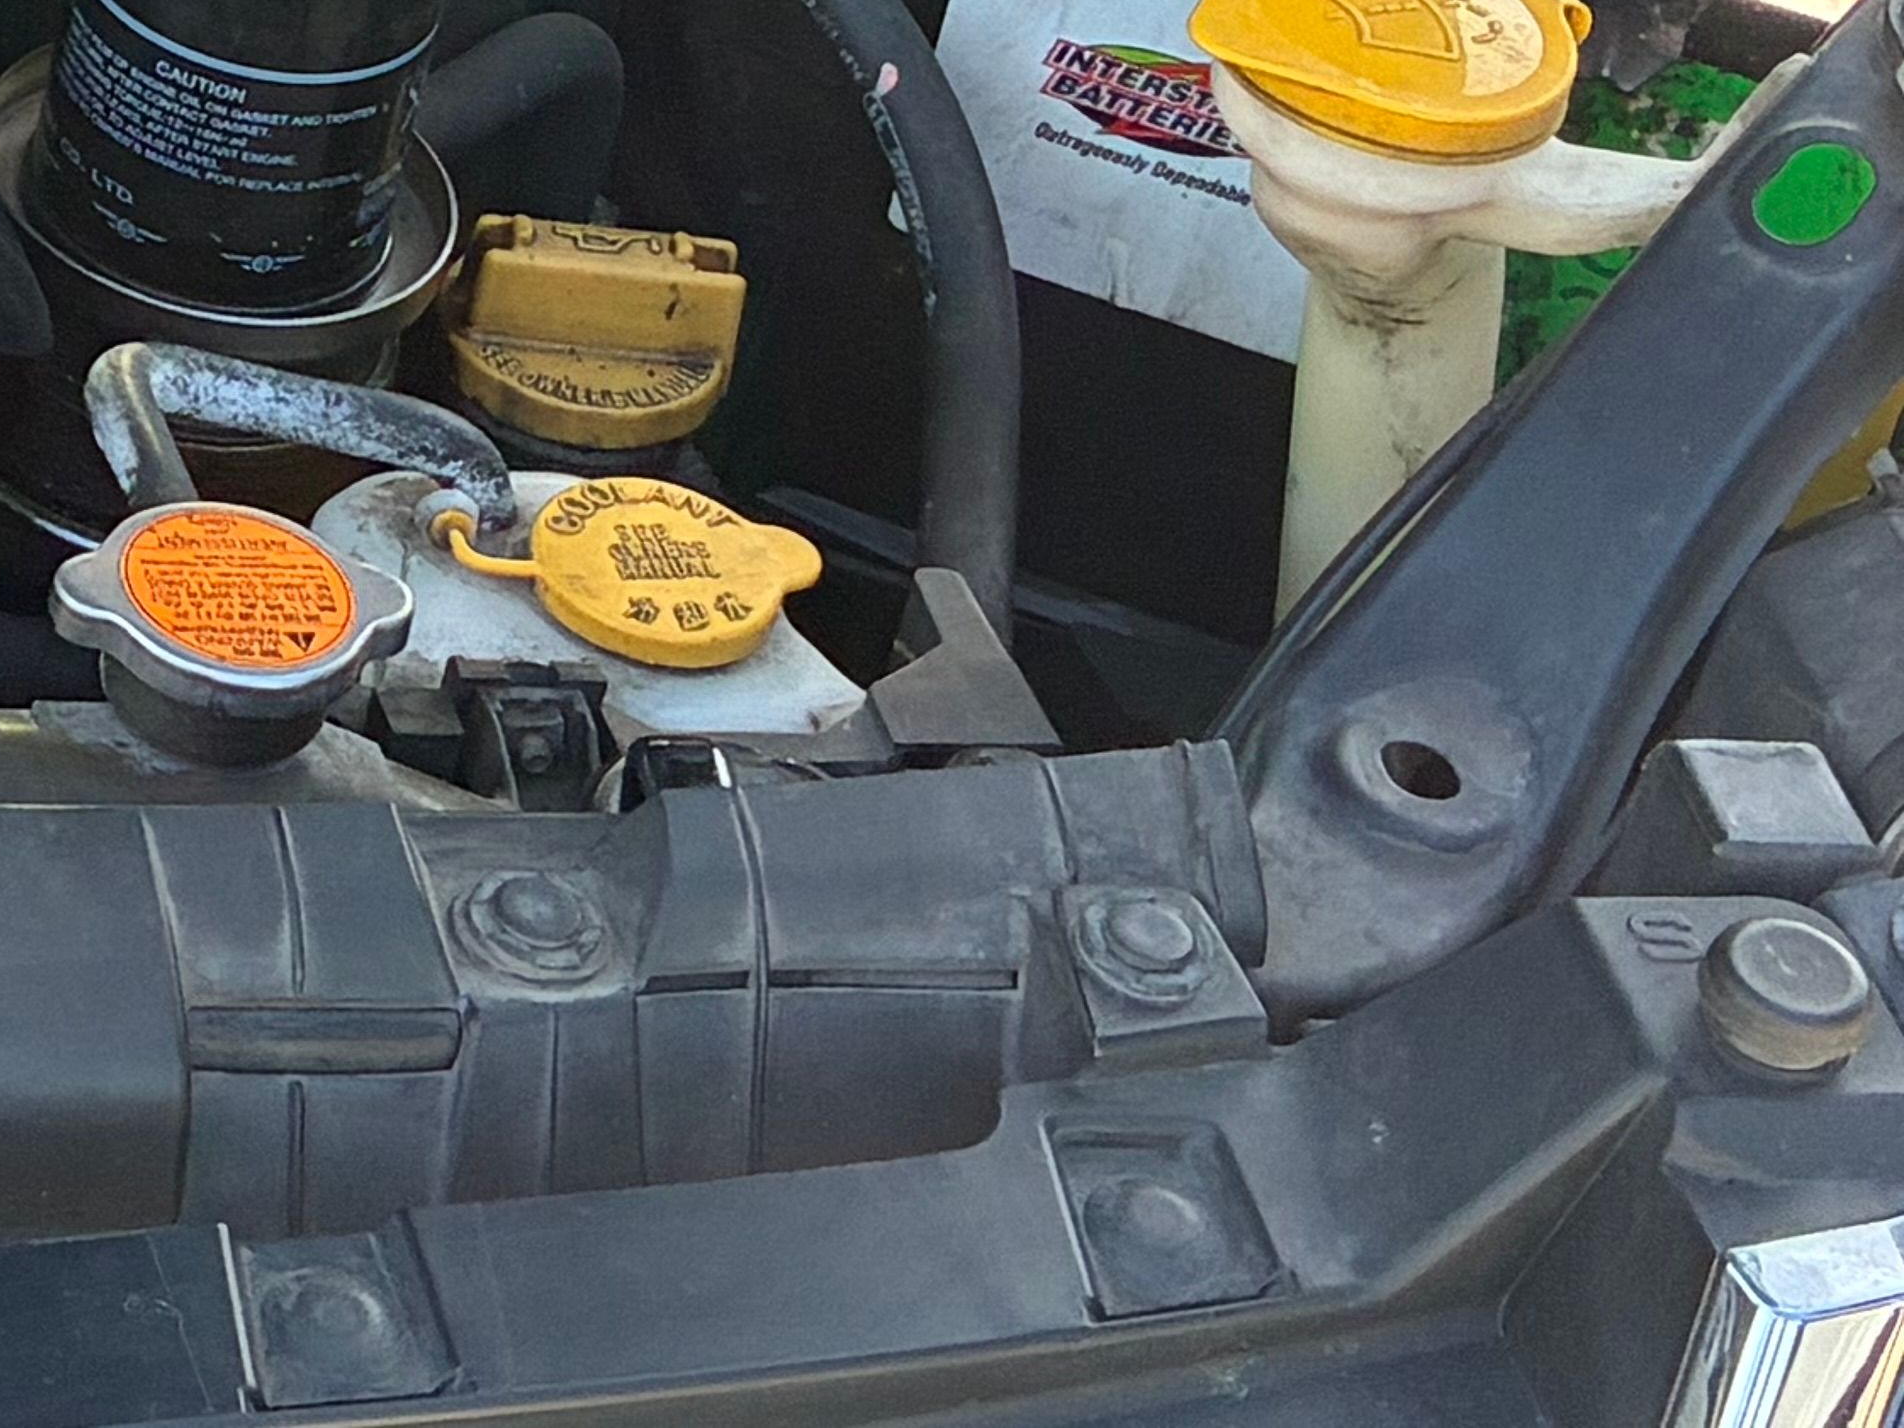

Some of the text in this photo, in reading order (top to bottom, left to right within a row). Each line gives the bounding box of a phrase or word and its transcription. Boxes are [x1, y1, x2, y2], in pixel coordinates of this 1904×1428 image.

[155, 59, 247, 103] CAUTION
[143, 88, 208, 123] CONTACT
[178, 92, 202, 110] OIL
[204, 101, 228, 117] ON
[230, 108, 291, 126] GASKET
[291, 114, 323, 127] AND
[145, 119, 190, 146] AFTER
[192, 138, 240, 159] START
[143, 147, 202, 180] MANUAL
[204, 171, 236, 186] FOR
[238, 176, 305, 193] REPLACE
[1034, 121, 1252, 207] Outrageously Dependable
[480, 343, 521, 377] SEE
[545, 482, 742, 536] COOLANT
[613, 522, 671, 544] SEE
